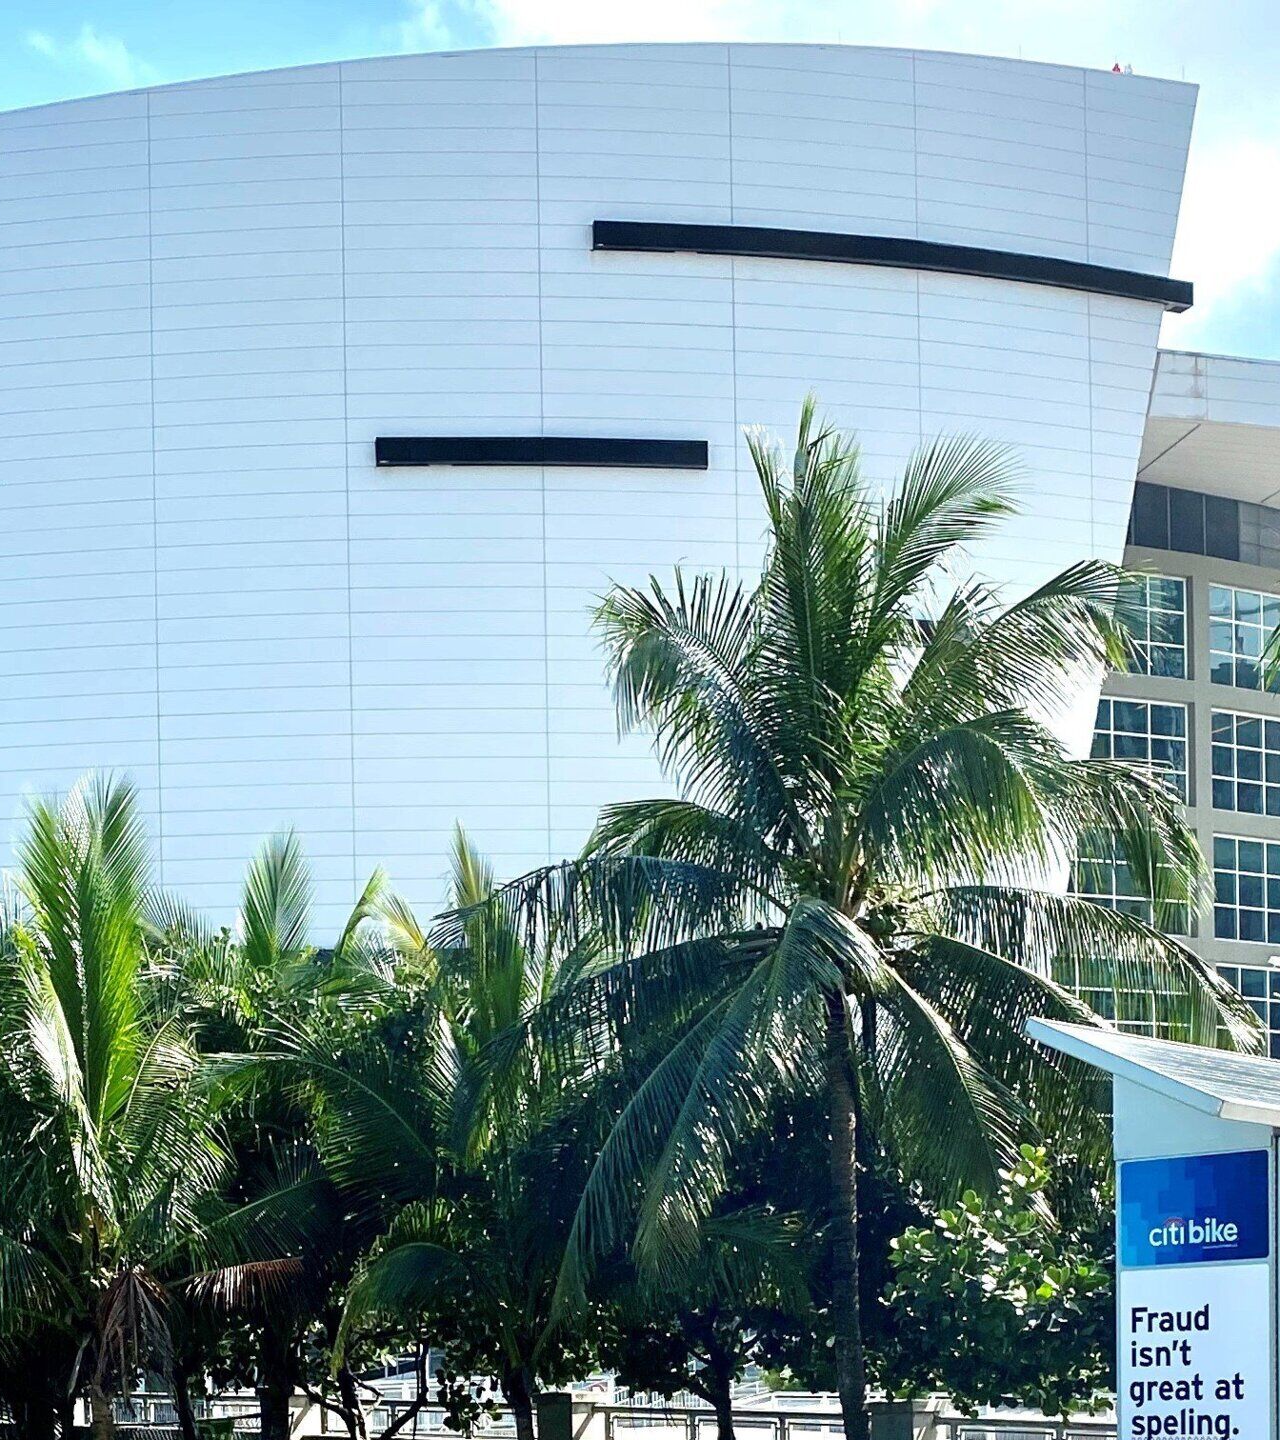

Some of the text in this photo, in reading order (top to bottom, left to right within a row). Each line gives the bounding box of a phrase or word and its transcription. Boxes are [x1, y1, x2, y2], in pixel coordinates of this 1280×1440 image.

[1149, 1217, 1239, 1247] citi bike
[1131, 1303, 1210, 1333] Fraud
[1130, 1372, 1244, 1408] great at
